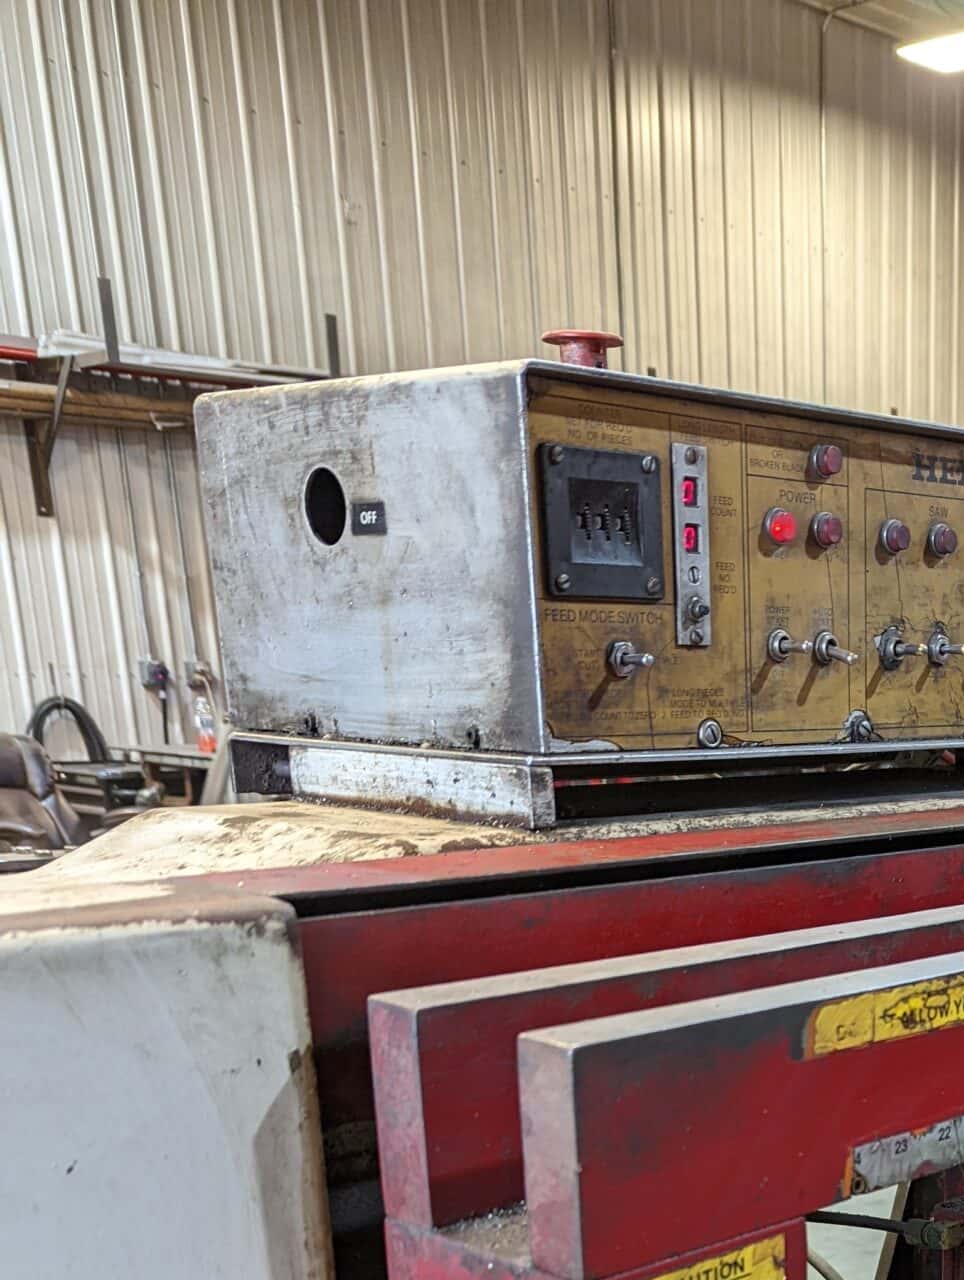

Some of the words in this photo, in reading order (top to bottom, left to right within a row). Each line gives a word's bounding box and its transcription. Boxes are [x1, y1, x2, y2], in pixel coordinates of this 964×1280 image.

[779, 488, 818, 505] POWER
[360, 510, 377, 525] OFF
[929, 505, 948, 519] SAW
[543, 608, 577, 623] FEED
[579, 610, 615, 624] MODE
[616, 610, 664, 625] SWITCH
[895, 1139, 909, 1154] 23
[938, 1126, 952, 1142] 22
